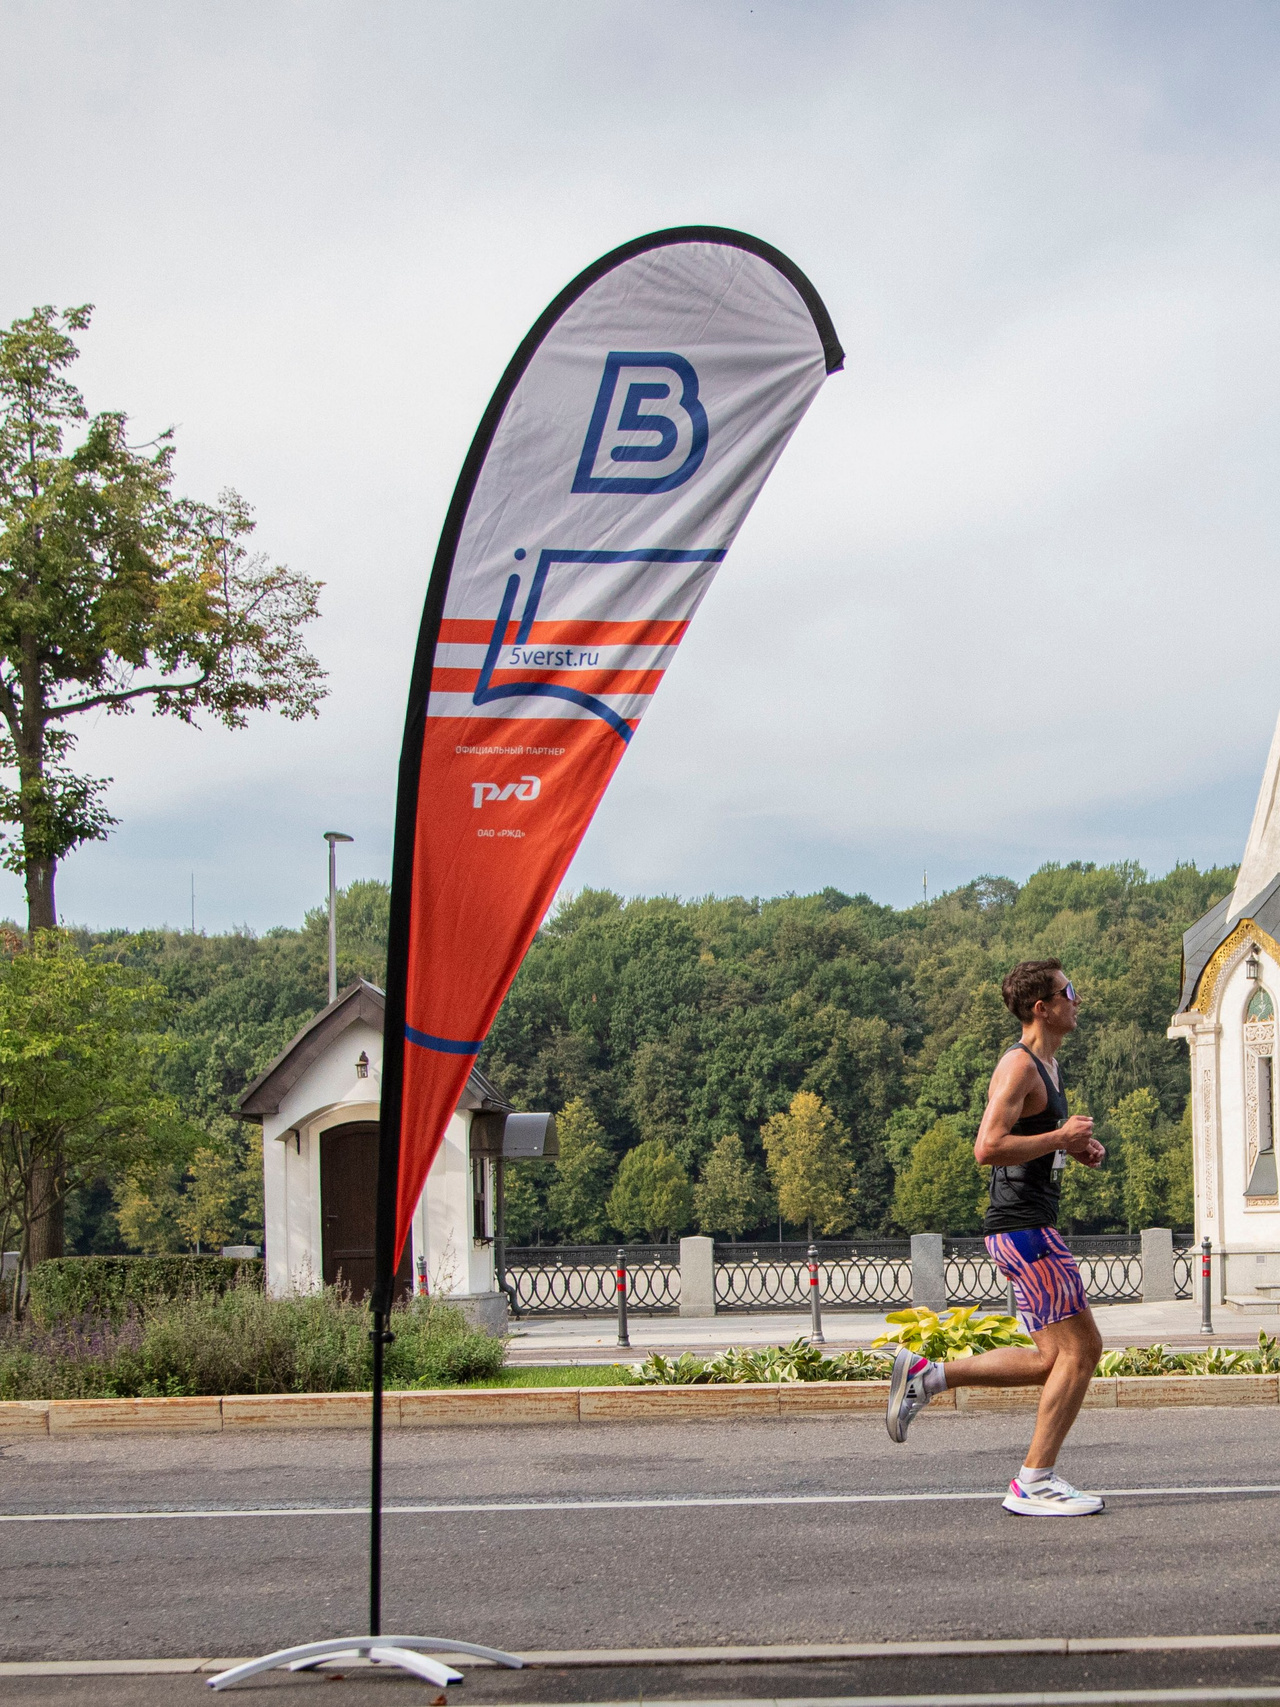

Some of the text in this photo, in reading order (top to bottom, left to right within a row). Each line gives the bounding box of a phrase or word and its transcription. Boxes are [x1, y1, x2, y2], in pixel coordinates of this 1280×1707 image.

[509, 647, 599, 667] 5verst.ru
[455, 745, 566, 755] ОФИЦИАЛЬНЫЙ ПАРТНЕР
[477, 829, 495, 837] ОАО
